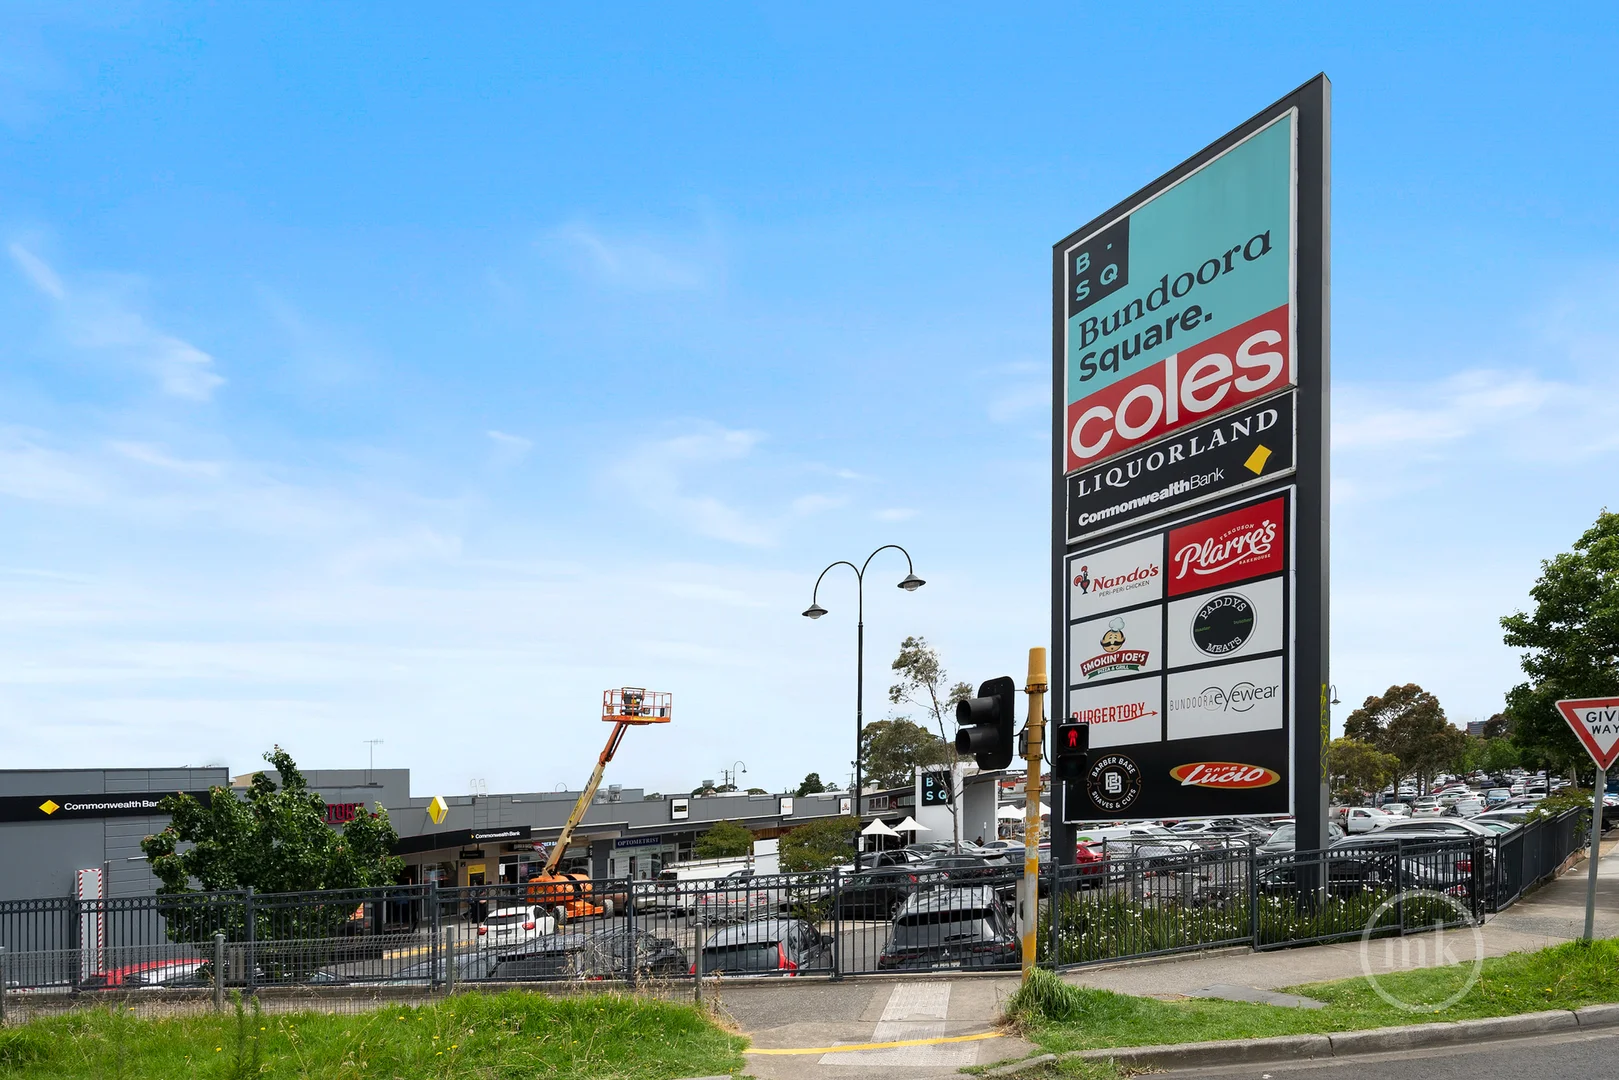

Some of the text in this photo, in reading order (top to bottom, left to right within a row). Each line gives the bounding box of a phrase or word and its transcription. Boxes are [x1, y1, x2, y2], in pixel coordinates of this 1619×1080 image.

[1076, 252, 1091, 276] B
[1076, 263, 1118, 302] S Q
[1078, 229, 1272, 351] Bundoora
[1078, 304, 1213, 382] Square.
[1070, 330, 1284, 459] coles
[1077, 408, 1279, 498] LIQUORLAND
[1219, 523, 1255, 541] FERGUSON
[1174, 519, 1277, 580] Plarre's
[1238, 553, 1271, 565] BAKEHOUSE
[1091, 563, 1159, 592] Nando's
[1125, 580, 1150, 591] CHICKEN
[1199, 597, 1247, 620] PADDYS
[1205, 636, 1242, 653] MEATS
[1082, 652, 1146, 673] SMOKIN' JOE'S
[1169, 683, 1279, 711] BUNDOORA eyewear
[1585, 710, 1619, 723] GIV
[1591, 724, 1619, 735] WAY
[1091, 757, 1136, 777] BARBER BASE
[1180, 764, 1265, 786] Lucio
[926, 777, 933, 787] B
[64, 800, 159, 811] Commonwealth Ban
[1092, 791, 1114, 808] SHAVES
[1121, 789, 1136, 805] CUTS
[617, 837, 659, 846] OPTOMETRIST
